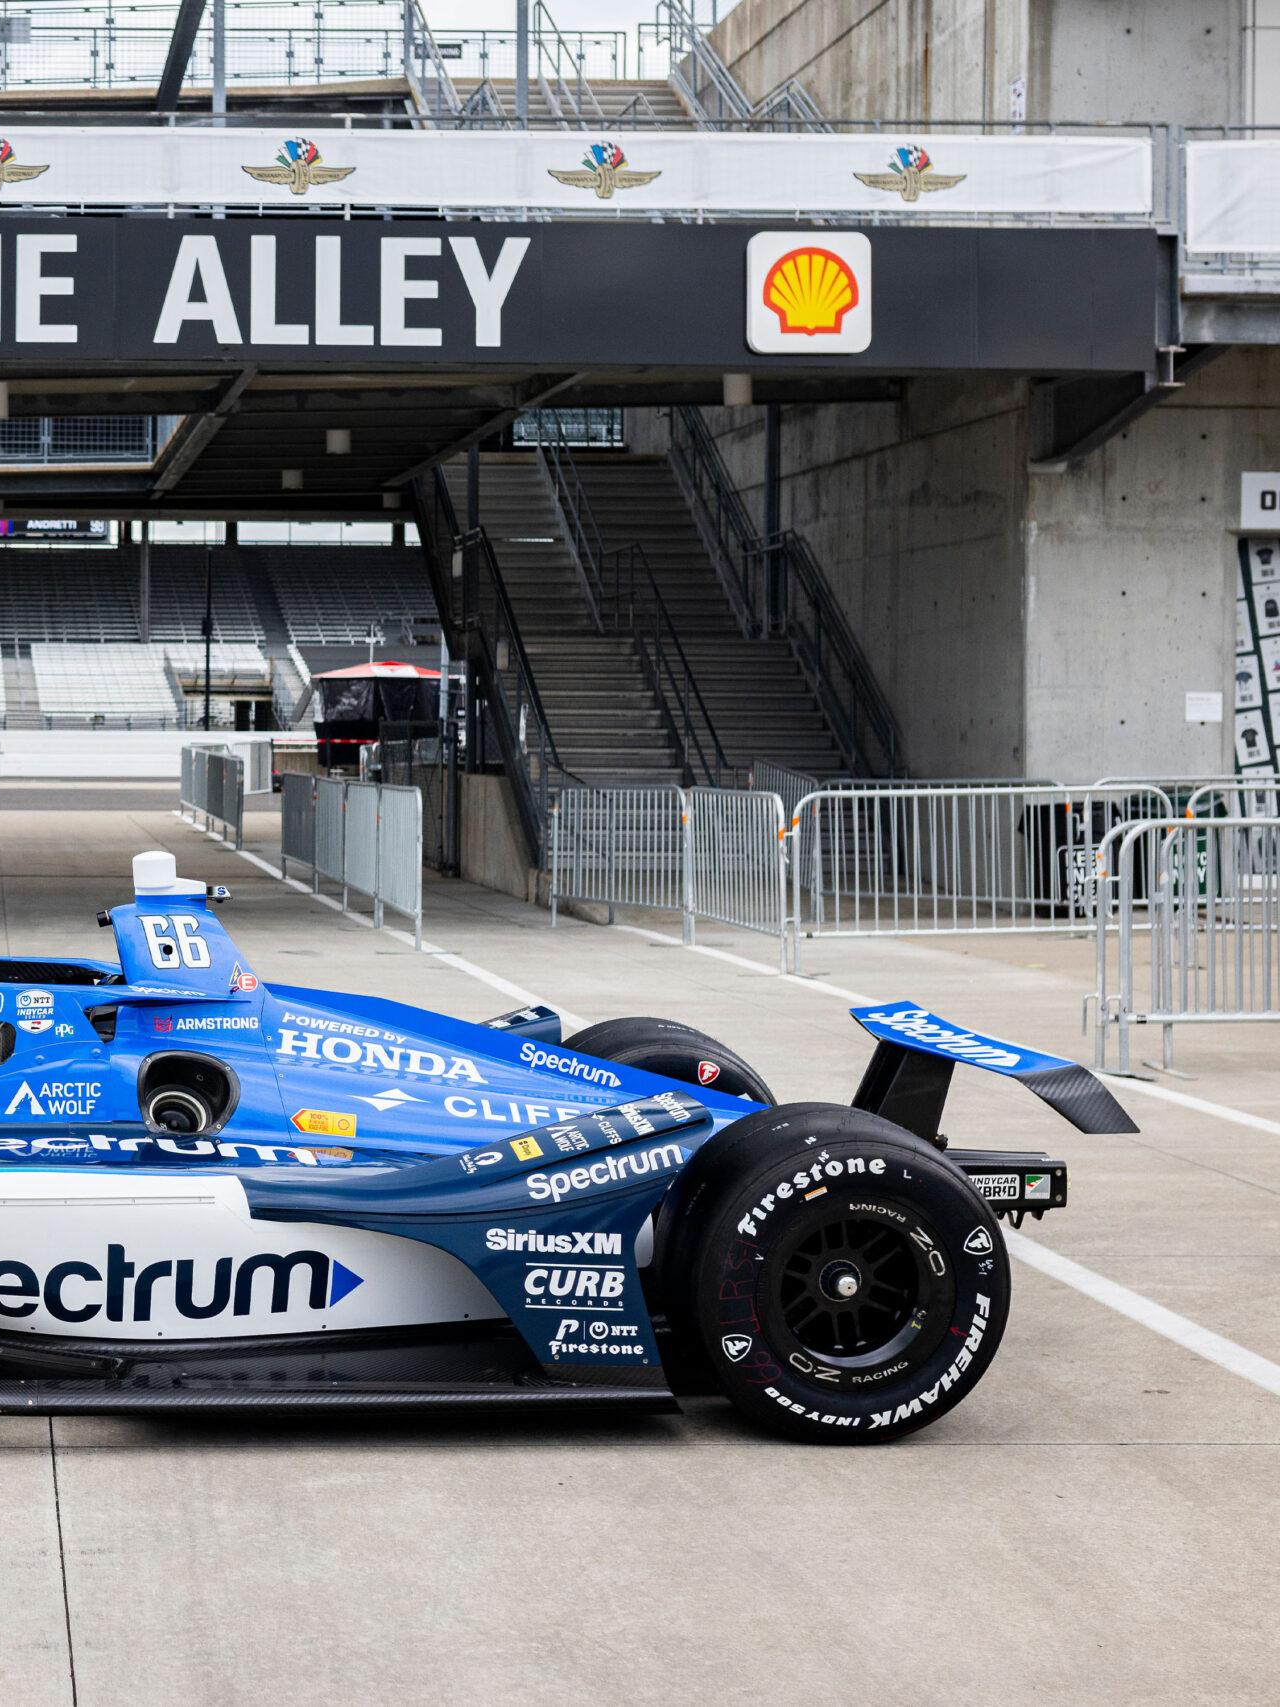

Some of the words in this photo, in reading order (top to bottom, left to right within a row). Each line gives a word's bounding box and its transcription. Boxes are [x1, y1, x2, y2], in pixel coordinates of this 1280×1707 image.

[153, 234, 531, 348] ALLEY
[136, 914, 212, 969] 66
[17, 1008, 54, 1016] INDYCAR
[176, 1017, 259, 1030] ARMSTRONG
[282, 1012, 380, 1038] POWERED
[276, 1029, 489, 1084] HONDA
[520, 1042, 616, 1087] Spectrum
[39, 1083, 102, 1098] ARCTIC
[47, 1100, 96, 1115] WOLF
[444, 1096, 582, 1124] CLIFF
[568, 1131, 590, 1151] ARCTIC
[599, 1121, 623, 1144] CLIFFS
[526, 1143, 685, 1202] Spectrum
[973, 1177, 1017, 1185] INDYCAR
[737, 1158, 887, 1236] Firestone
[485, 1228, 622, 1255] SiriusXM
[524, 1269, 625, 1297] CURB
[526, 1298, 623, 1307] RECORDS
[611, 1326, 638, 1336] NTT
[548, 1340, 644, 1355] Firestone
[852, 1361, 909, 1383] RACING
[867, 1293, 991, 1430] FIREHAWK
